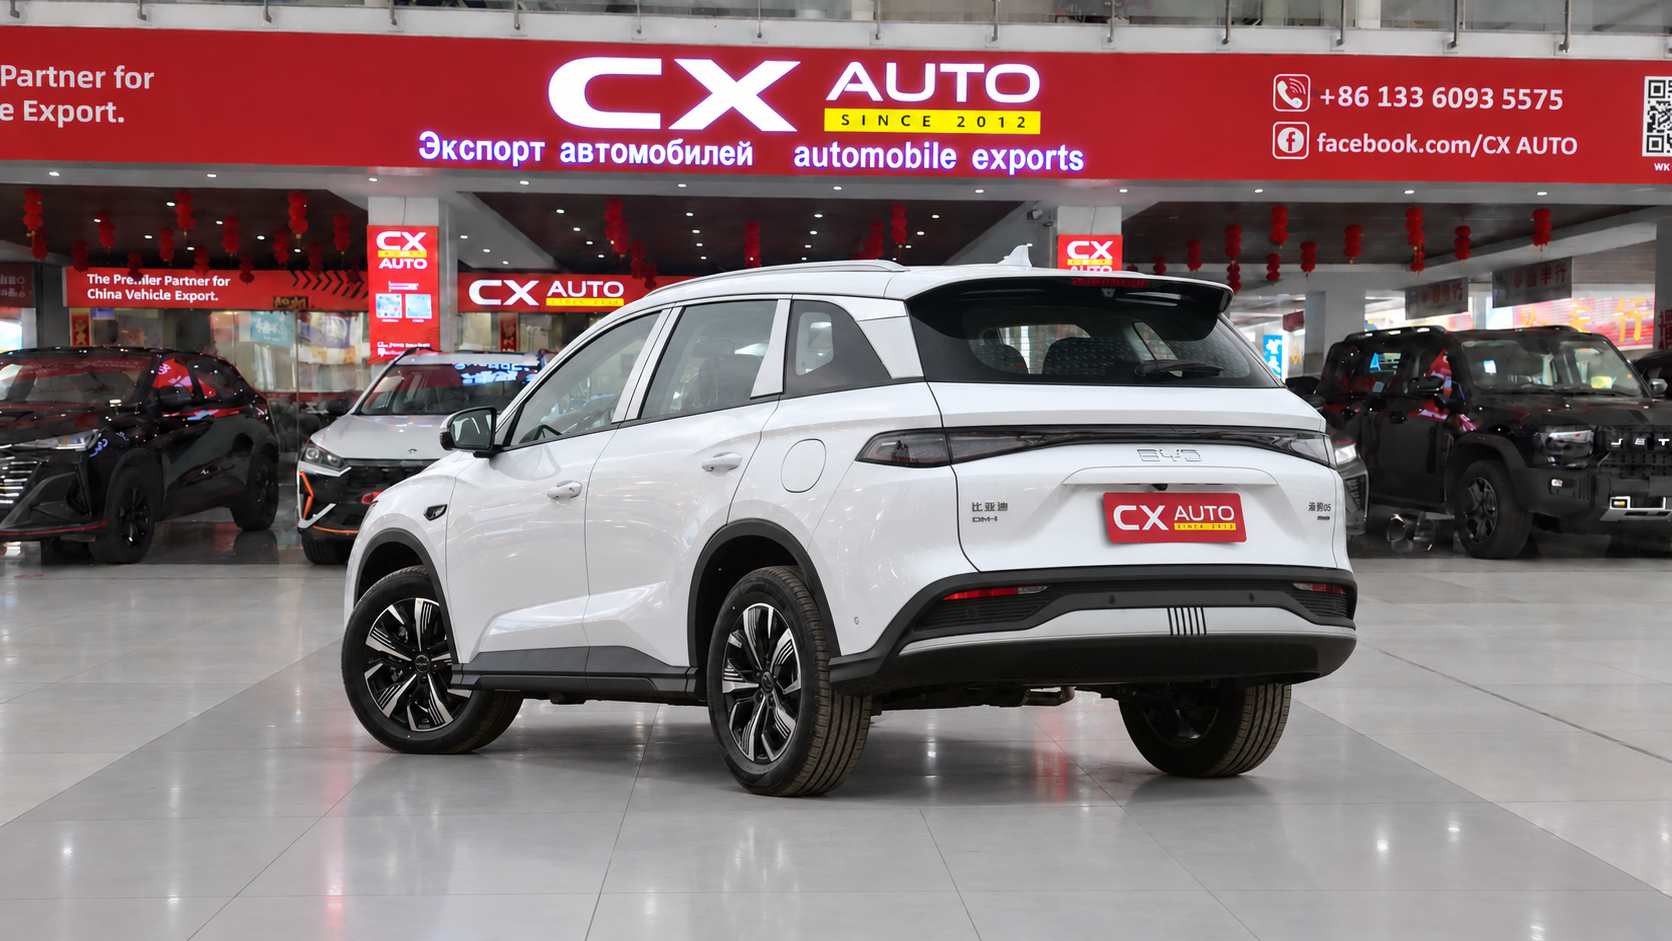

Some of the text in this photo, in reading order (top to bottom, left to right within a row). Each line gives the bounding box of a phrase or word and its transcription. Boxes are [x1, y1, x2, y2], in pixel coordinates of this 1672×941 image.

[1, 64, 154, 89] Partner for
[547, 57, 1040, 132] CX AUTO
[1320, 85, 1563, 110] +86 133 6093 5575
[23, 100, 125, 128] Export.
[841, 114, 1027, 129] SINCE 2012
[418, 130, 753, 167] Экспорт автомобилей
[1317, 132, 1578, 157] facebook.com/CX AUTO
[794, 141, 1084, 175] automobile exports
[376, 231, 427, 251] CX
[1067, 241, 1113, 259] CX
[379, 258, 428, 269] AUTO
[87, 274, 110, 284] The
[164, 275, 210, 287] Partner
[212, 276, 231, 287] for
[468, 280, 624, 306] CX AUTO
[87, 288, 219, 303] China Vehicle Export.
[1136, 448, 1203, 462] BYD
[1113, 505, 1235, 530] CX AUTO
